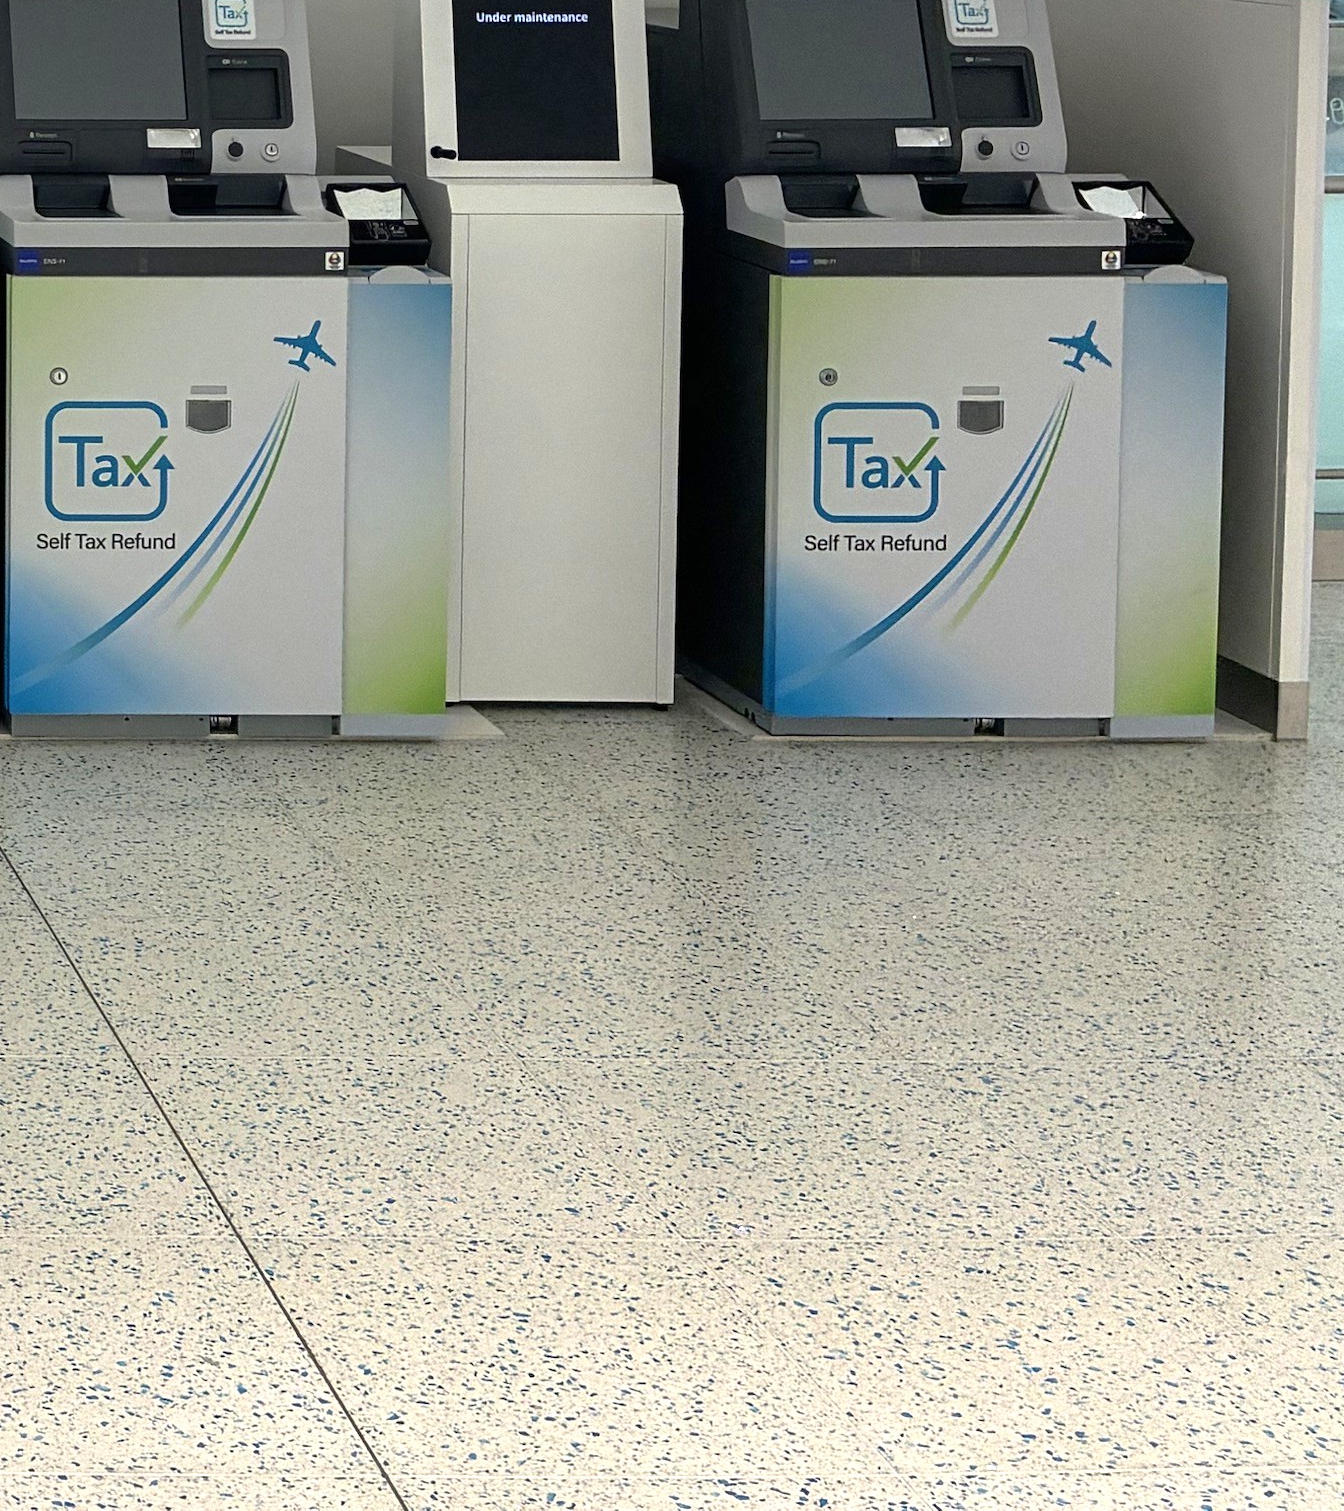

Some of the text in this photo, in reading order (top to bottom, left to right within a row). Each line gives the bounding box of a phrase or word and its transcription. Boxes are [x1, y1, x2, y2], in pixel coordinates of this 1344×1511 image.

[218, 5, 246, 20] Tax
[476, 11, 588, 23] Under maintenance
[58, 435, 168, 488] Tax
[827, 436, 939, 489] Tax
[36, 533, 176, 550] Self Tax Refund
[804, 534, 947, 552] Self Tax Refund
